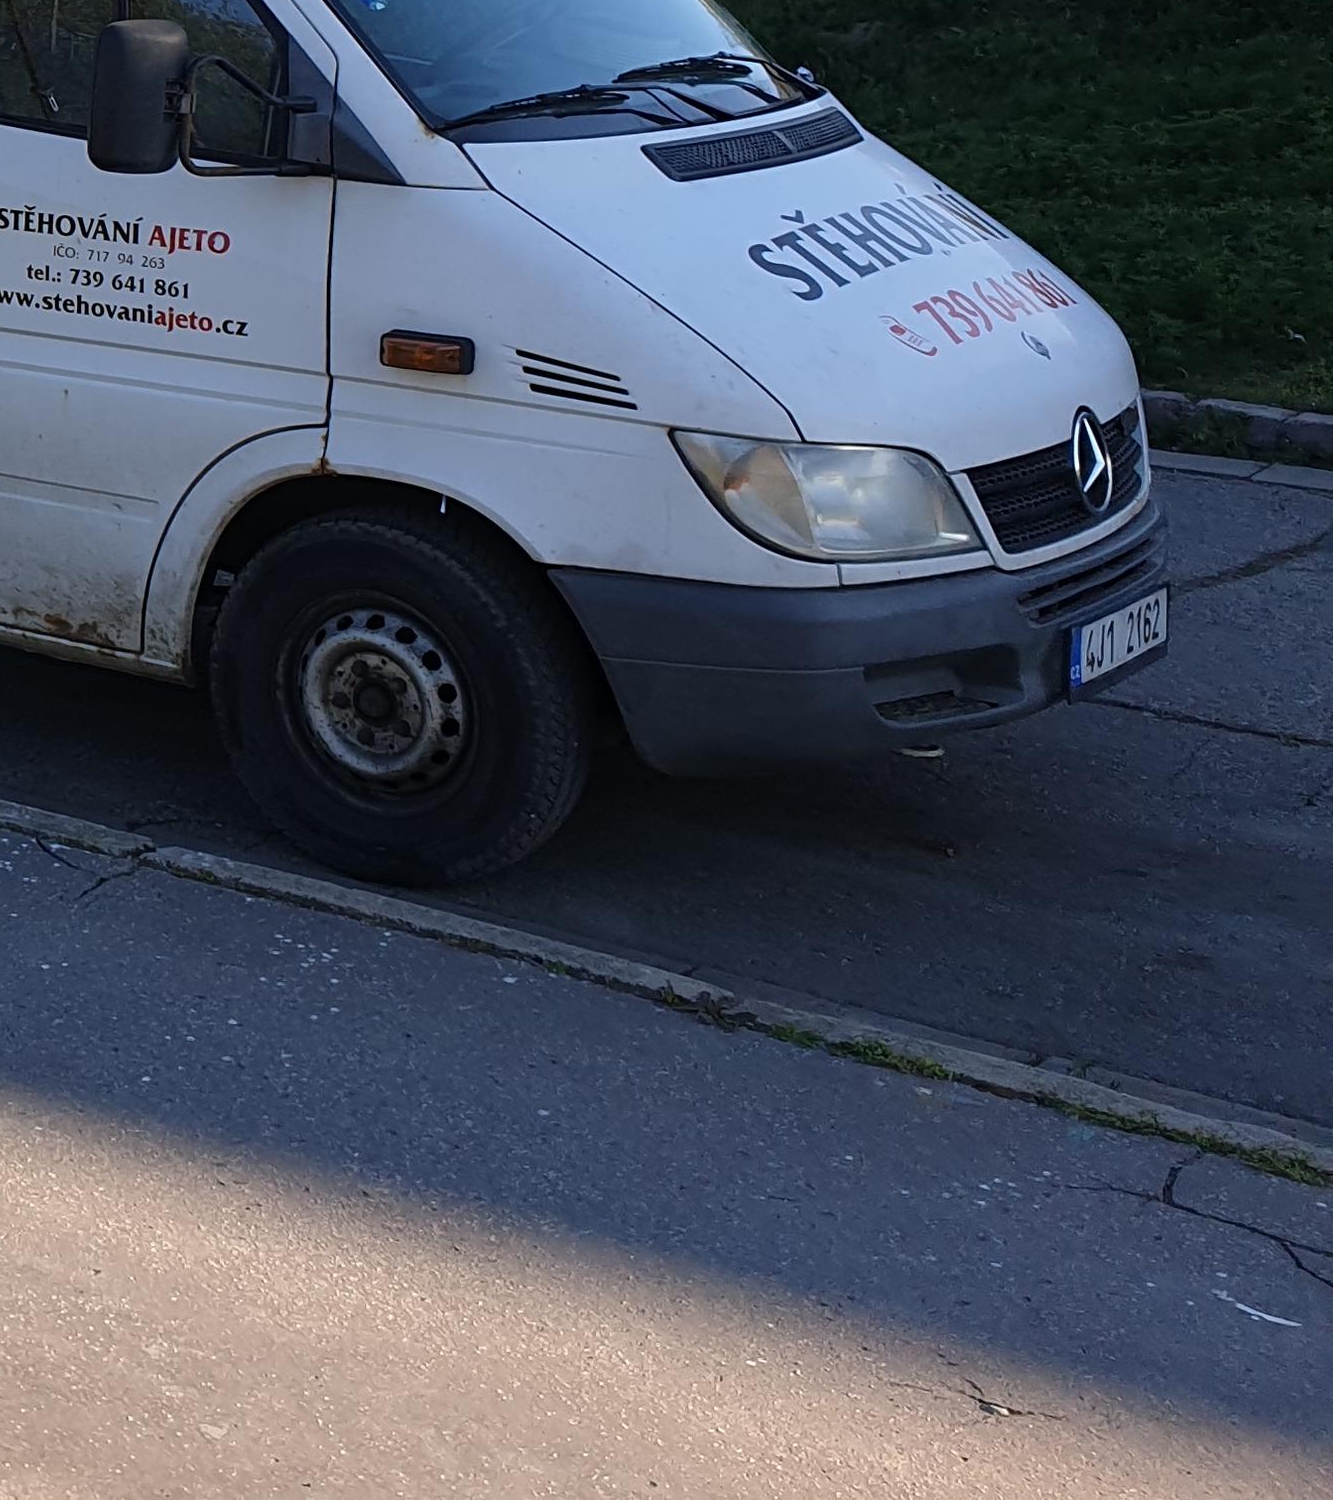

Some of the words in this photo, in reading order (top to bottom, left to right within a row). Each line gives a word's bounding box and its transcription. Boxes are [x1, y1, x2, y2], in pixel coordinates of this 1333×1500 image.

[53, 244, 80, 260] IČO:
[87, 248, 110, 264] 717
[117, 252, 134, 267] 94
[141, 255, 166, 270] 263
[148, 225, 231, 255] AJETO
[748, 182, 1010, 301] STĚHOVÁNÍ
[26, 264, 62, 284] tel.:
[69, 268, 104, 288] 739
[112, 273, 145, 294] 641
[154, 279, 190, 299] 861
[912, 290, 993, 345] 739
[973, 276, 1044, 322] 641
[1011, 268, 1078, 309] 861
[1070, 664, 1081, 680] CZ
[1086, 620, 1115, 673] 4J1
[1126, 598, 1161, 655] 2162
